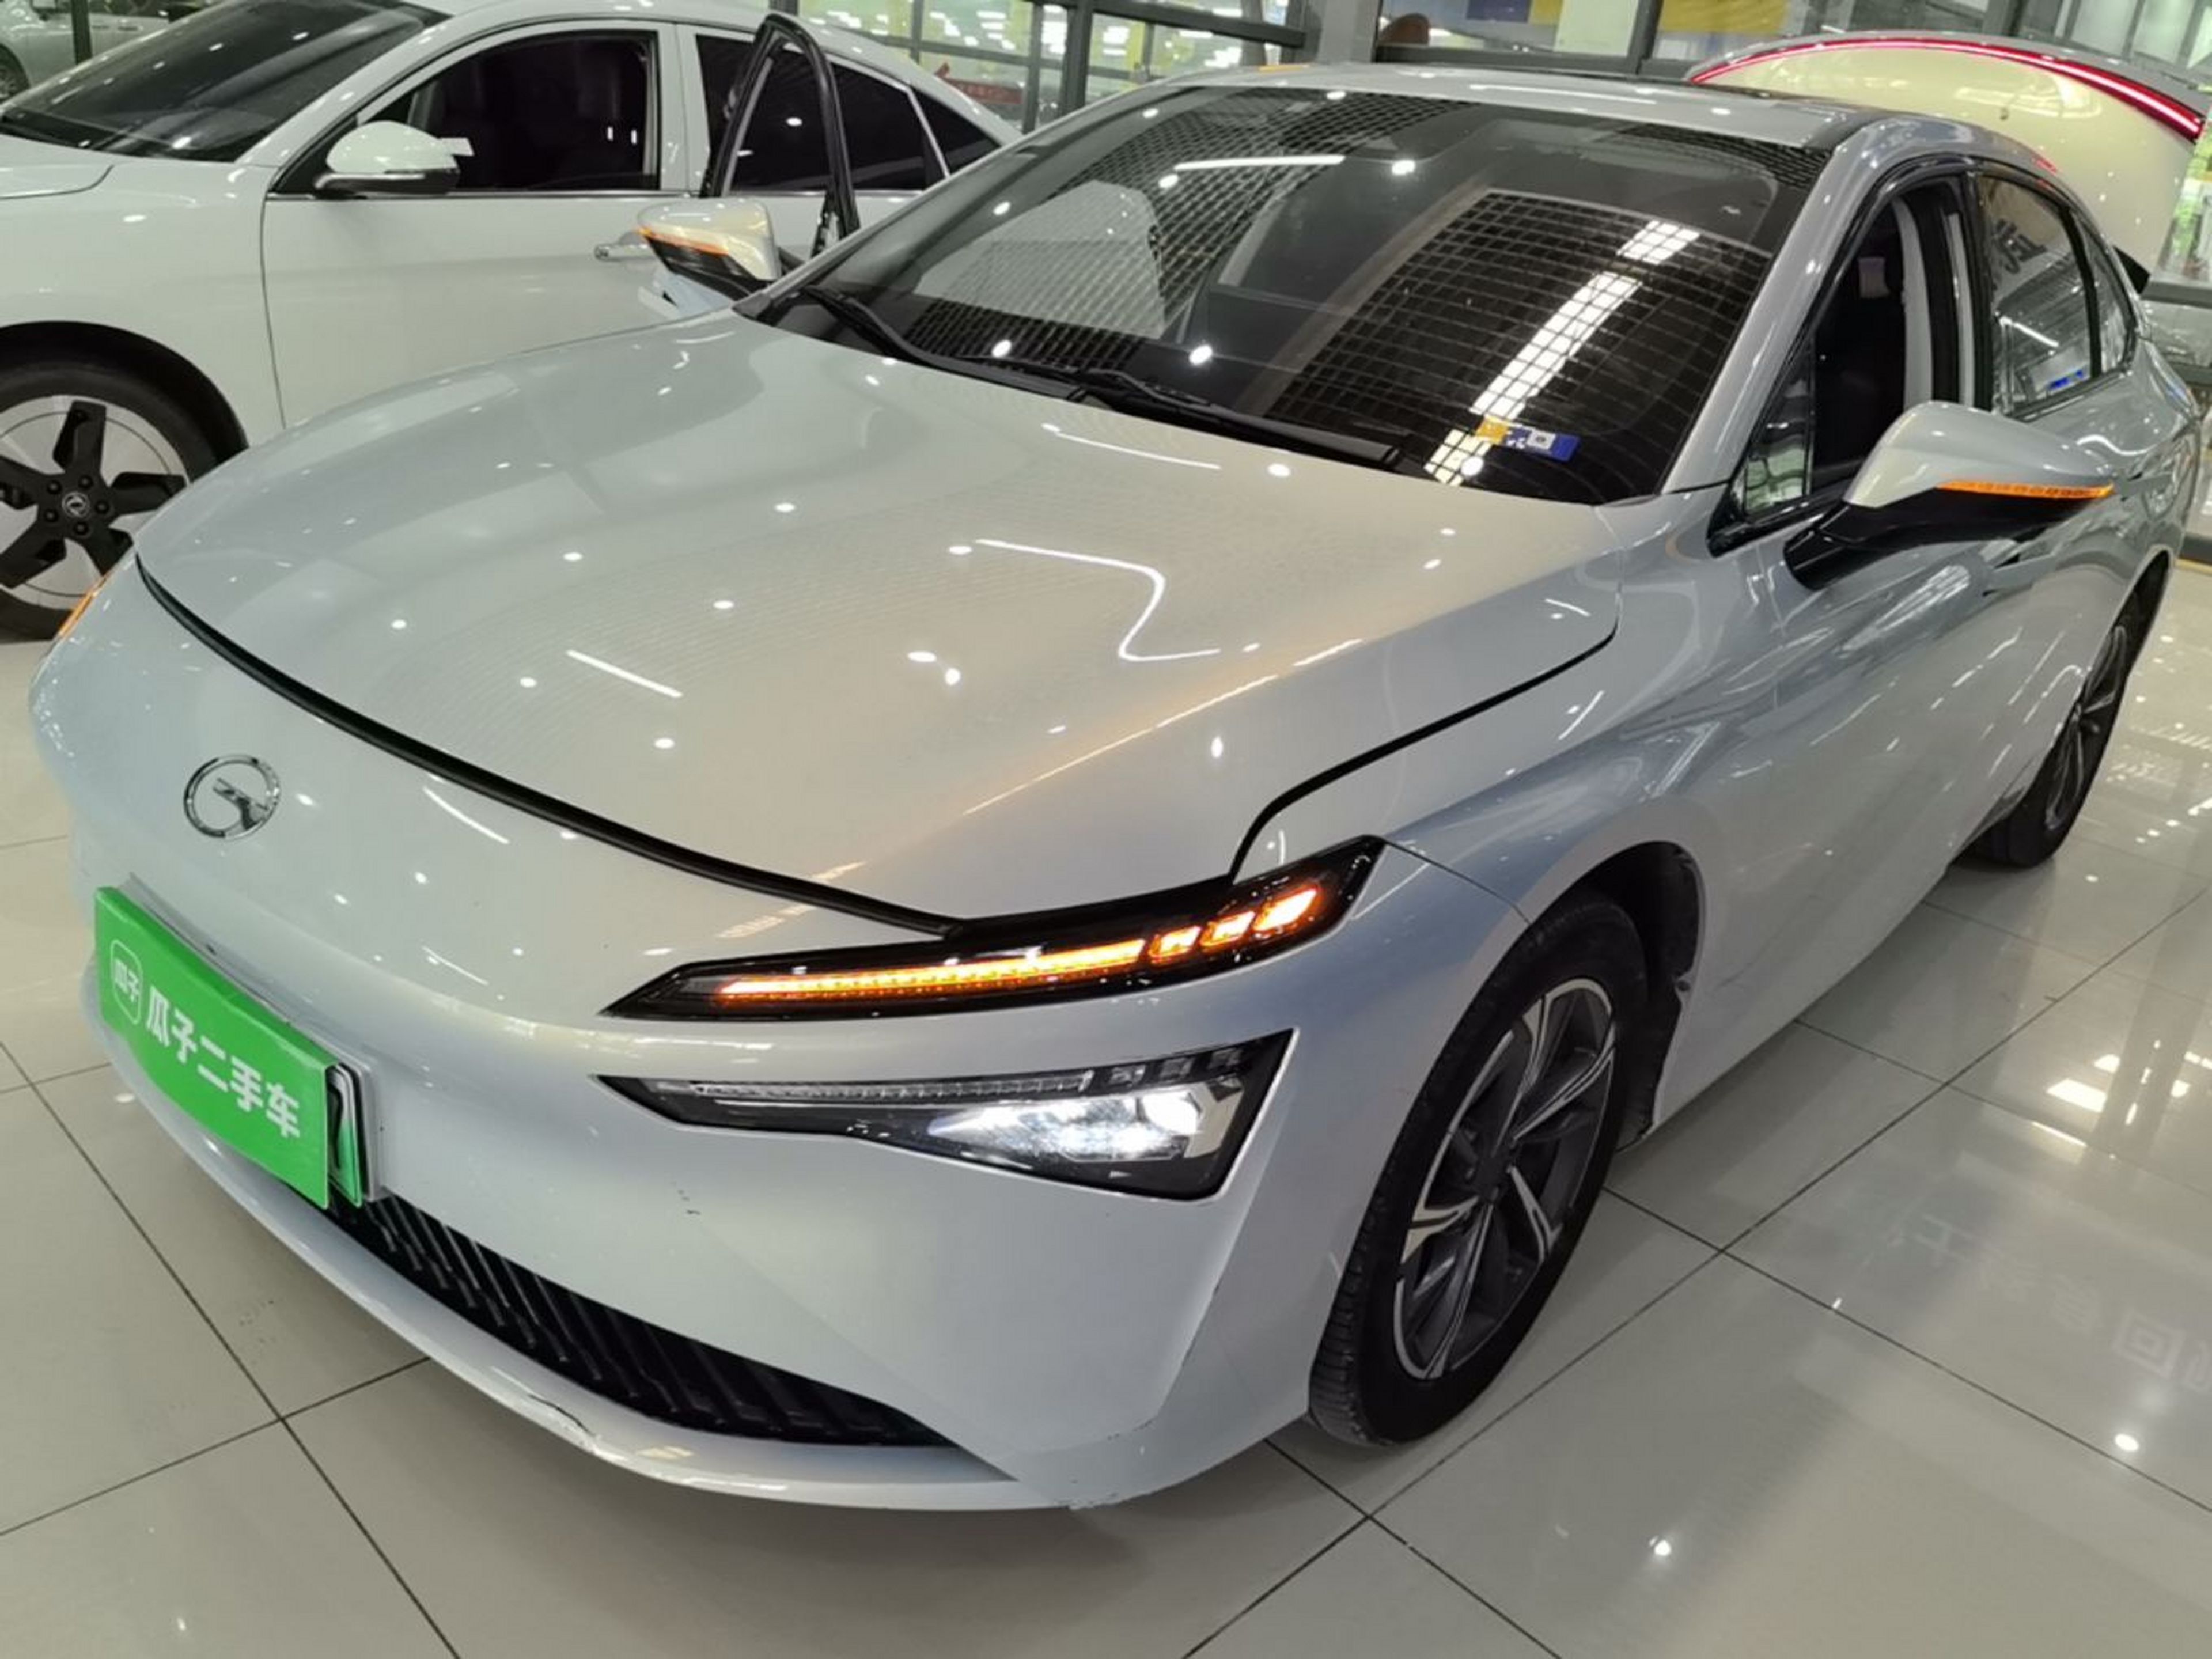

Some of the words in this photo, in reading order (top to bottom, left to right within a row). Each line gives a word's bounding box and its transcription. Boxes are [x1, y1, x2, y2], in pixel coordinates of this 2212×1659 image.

[146, 985, 300, 1138] 瓜子二手车
